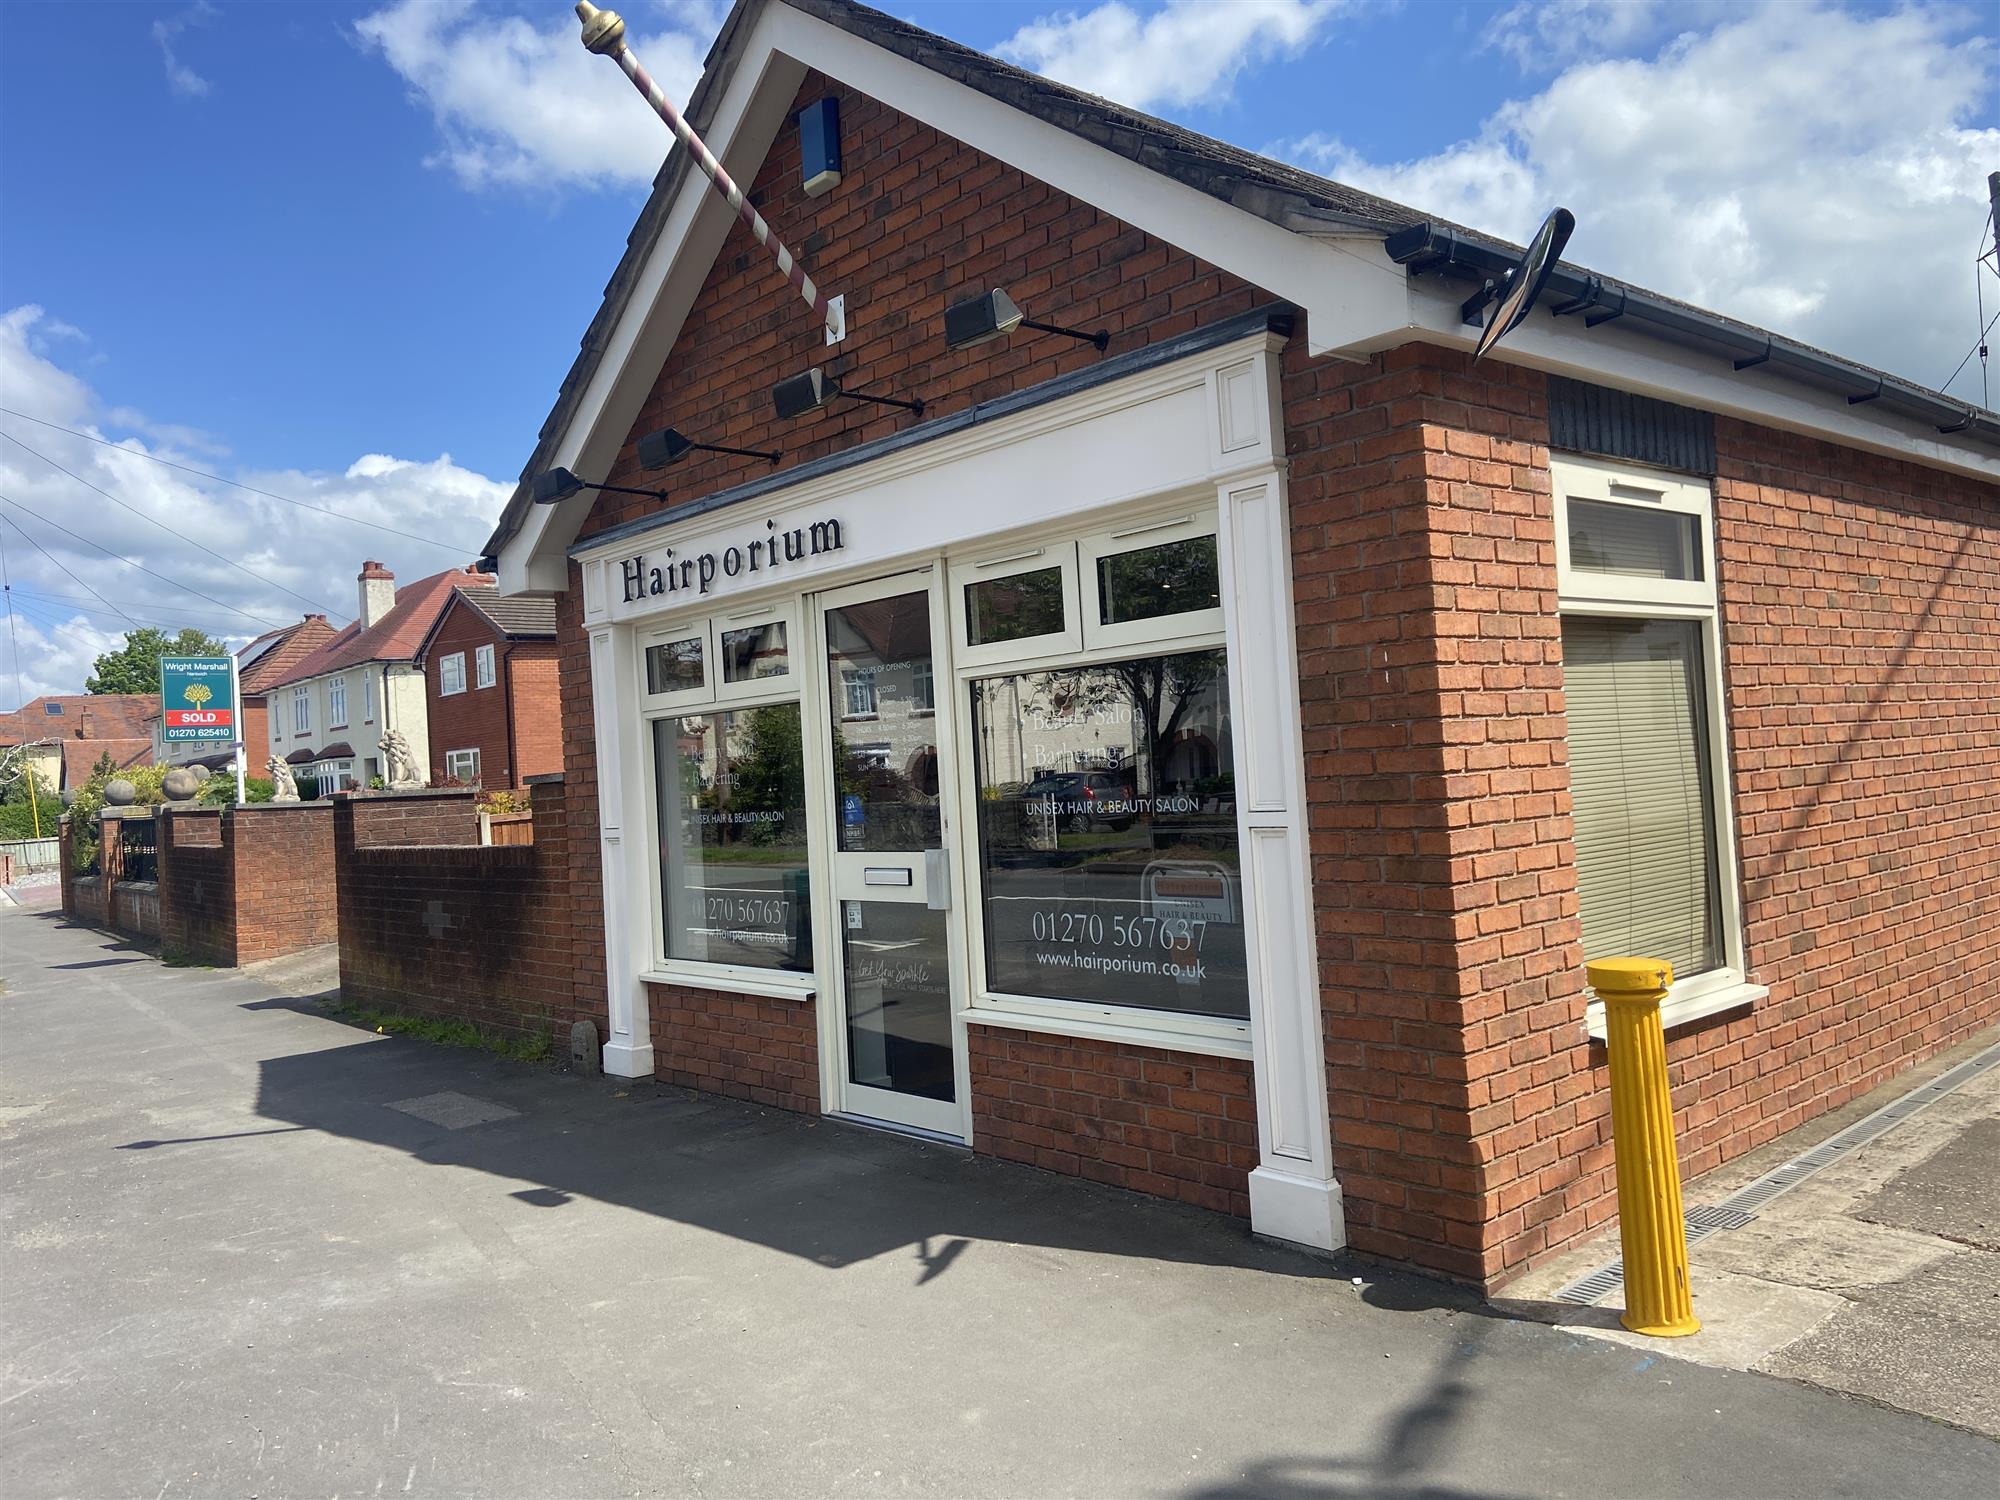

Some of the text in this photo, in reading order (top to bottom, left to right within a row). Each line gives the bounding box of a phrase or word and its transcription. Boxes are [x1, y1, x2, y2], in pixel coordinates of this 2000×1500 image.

[620, 518, 844, 603] Hairporium
[165, 663, 228, 672] Wright Marshall
[858, 661, 911, 675] HOURS OF OPENING
[876, 684, 897, 694] CLOSED
[182, 713, 216, 723] SOLD
[1094, 703, 1144, 725] Salon
[169, 728, 229, 738] 01270 625410
[1034, 741, 1119, 769] Barbering
[1026, 797, 1199, 816] UNISEX HAIR & BEAUTY SALON
[711, 813, 726, 824] HAIR
[727, 813, 733, 823] &
[734, 811, 758, 823] BEAUTY
[760, 810, 785, 822] SALON
[738, 899, 790, 926] 567637
[1190, 911, 1223, 921] BEAUTY
[1032, 911, 1207, 952] 01270 567637
[858, 958, 874, 976] Get
[1036, 949, 1207, 979] www.hairporium.co.uk
